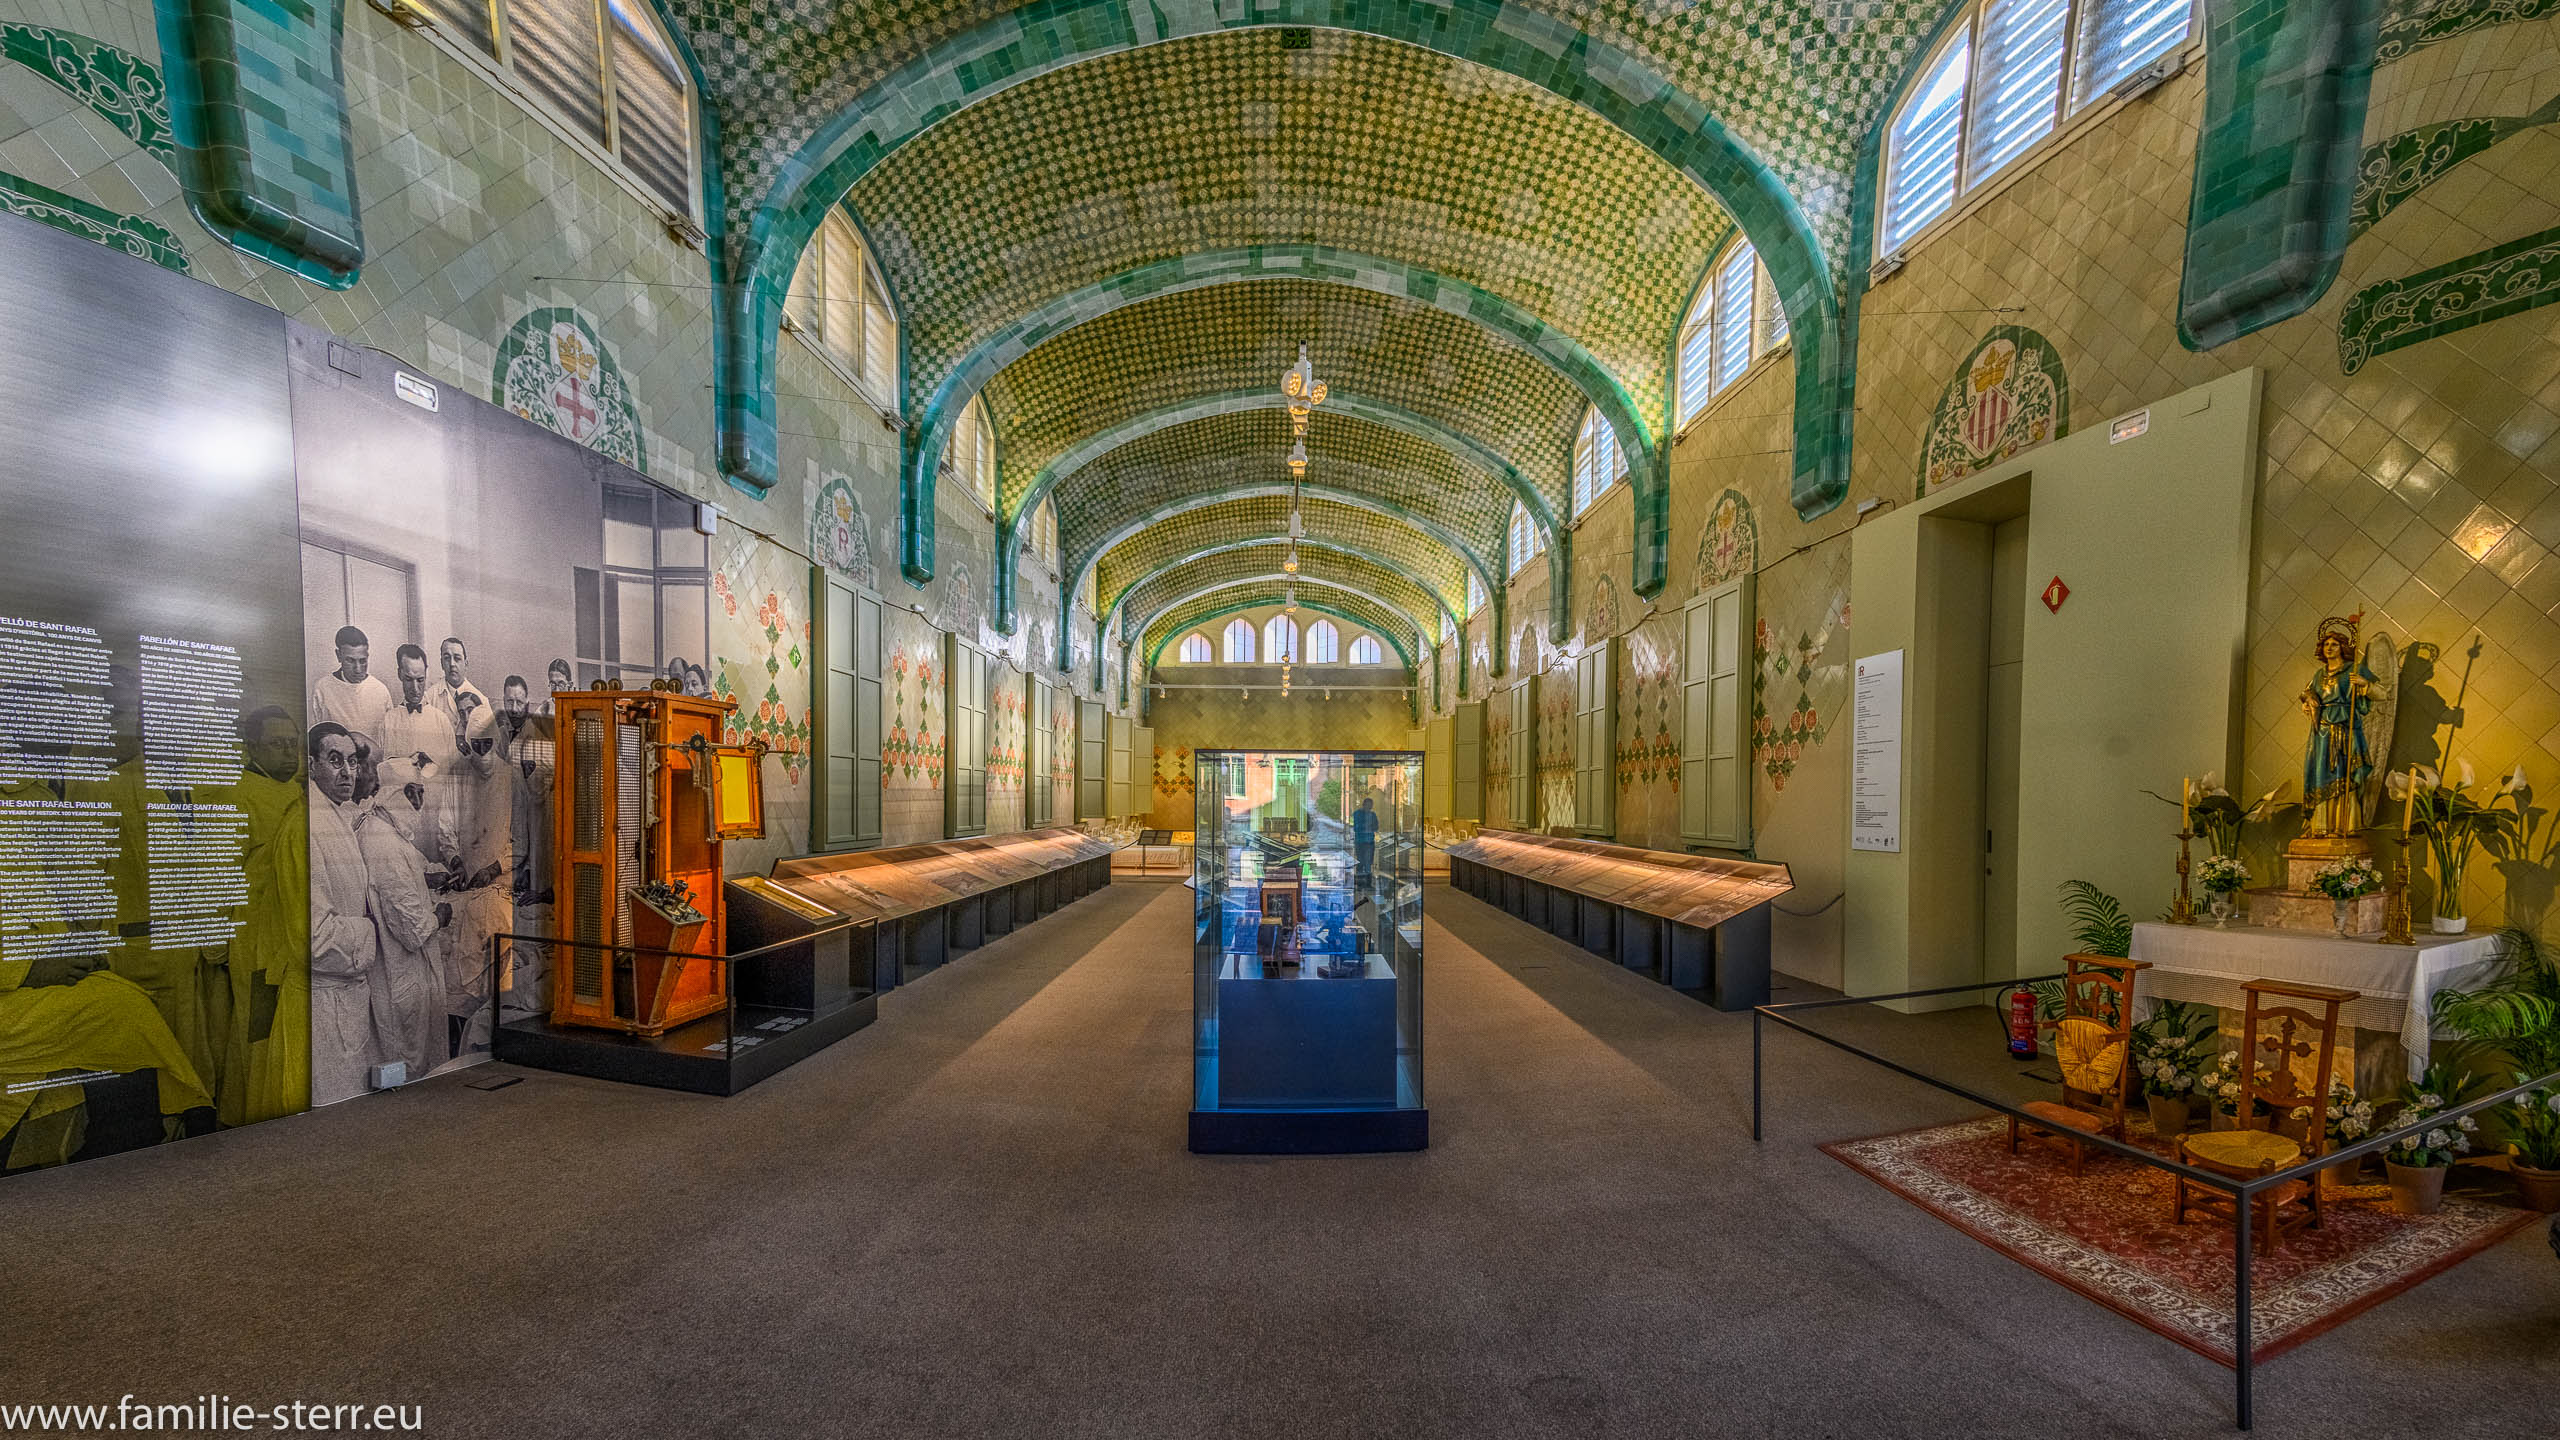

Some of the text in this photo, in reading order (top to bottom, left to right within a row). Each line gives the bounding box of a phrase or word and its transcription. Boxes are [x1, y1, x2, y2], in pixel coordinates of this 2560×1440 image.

[0, 616, 98, 636] ELLÓ DE SANT RAFAEL
[140, 635, 178, 646] PABELLÓN
[190, 641, 210, 650] SANT
[210, 644, 236, 654] RAFAEL
